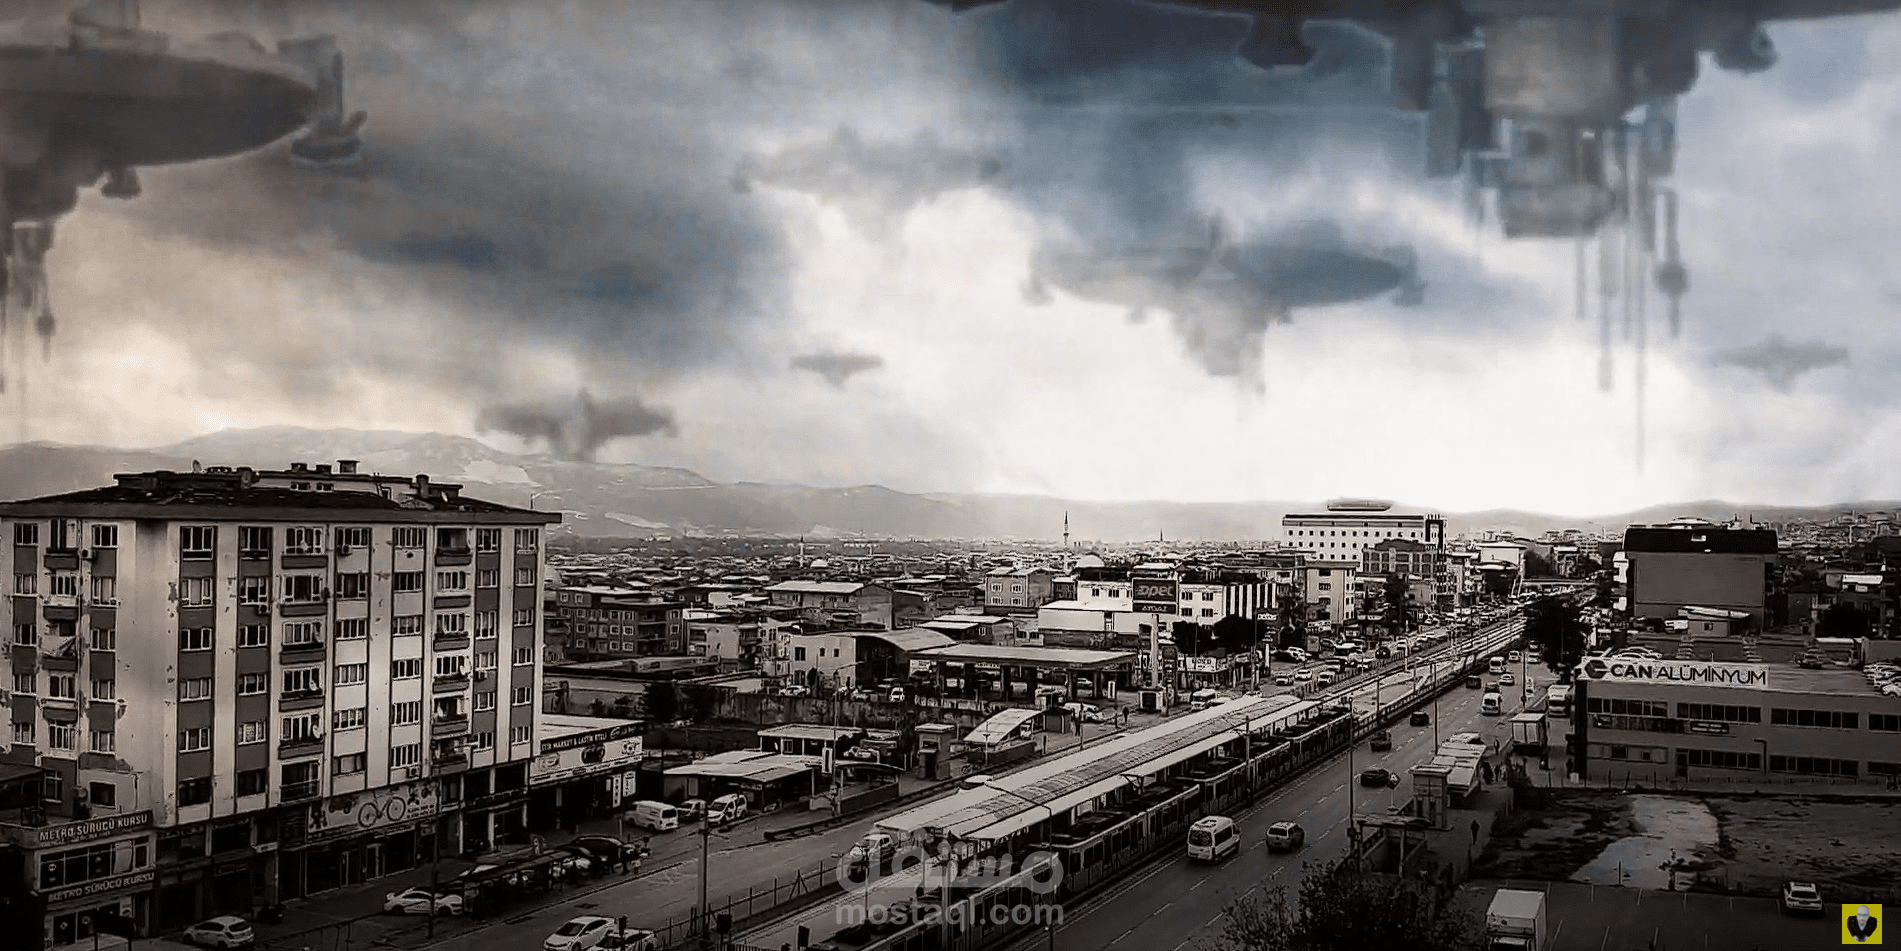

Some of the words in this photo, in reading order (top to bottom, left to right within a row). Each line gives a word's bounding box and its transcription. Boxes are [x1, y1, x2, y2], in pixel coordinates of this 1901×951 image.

[1610, 664, 1652, 679] CAN
[1656, 664, 1767, 686] ALÜMİNYUM
[40, 828, 74, 841] METRO
[118, 814, 148, 827] KURSU
